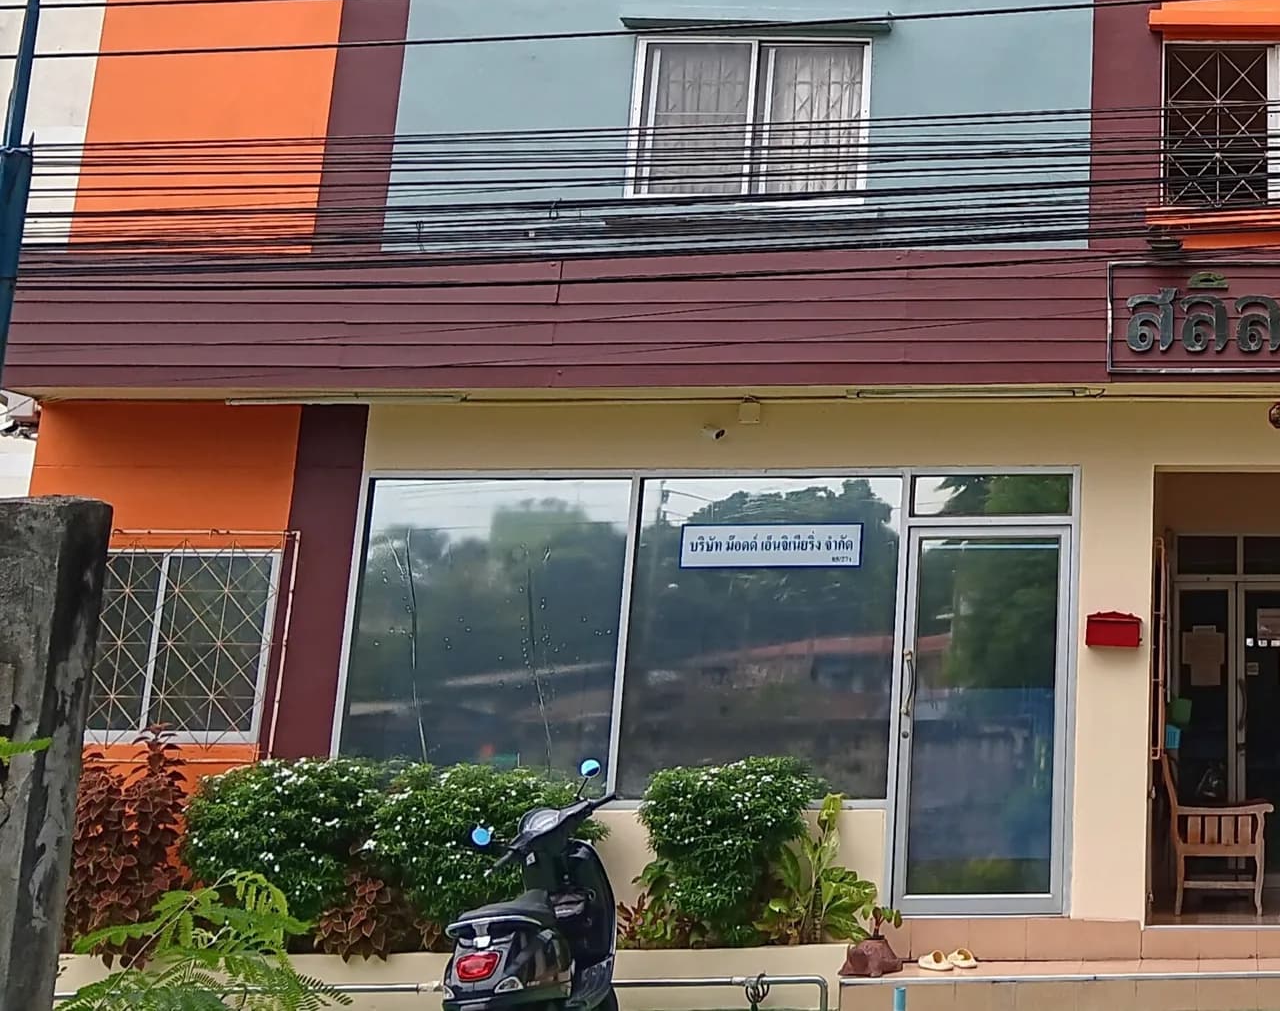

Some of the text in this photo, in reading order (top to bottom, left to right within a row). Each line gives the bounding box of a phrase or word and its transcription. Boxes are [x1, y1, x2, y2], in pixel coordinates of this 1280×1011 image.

[690, 535, 722, 552] บริษัท
[824, 534, 854, 552] จำกัด
